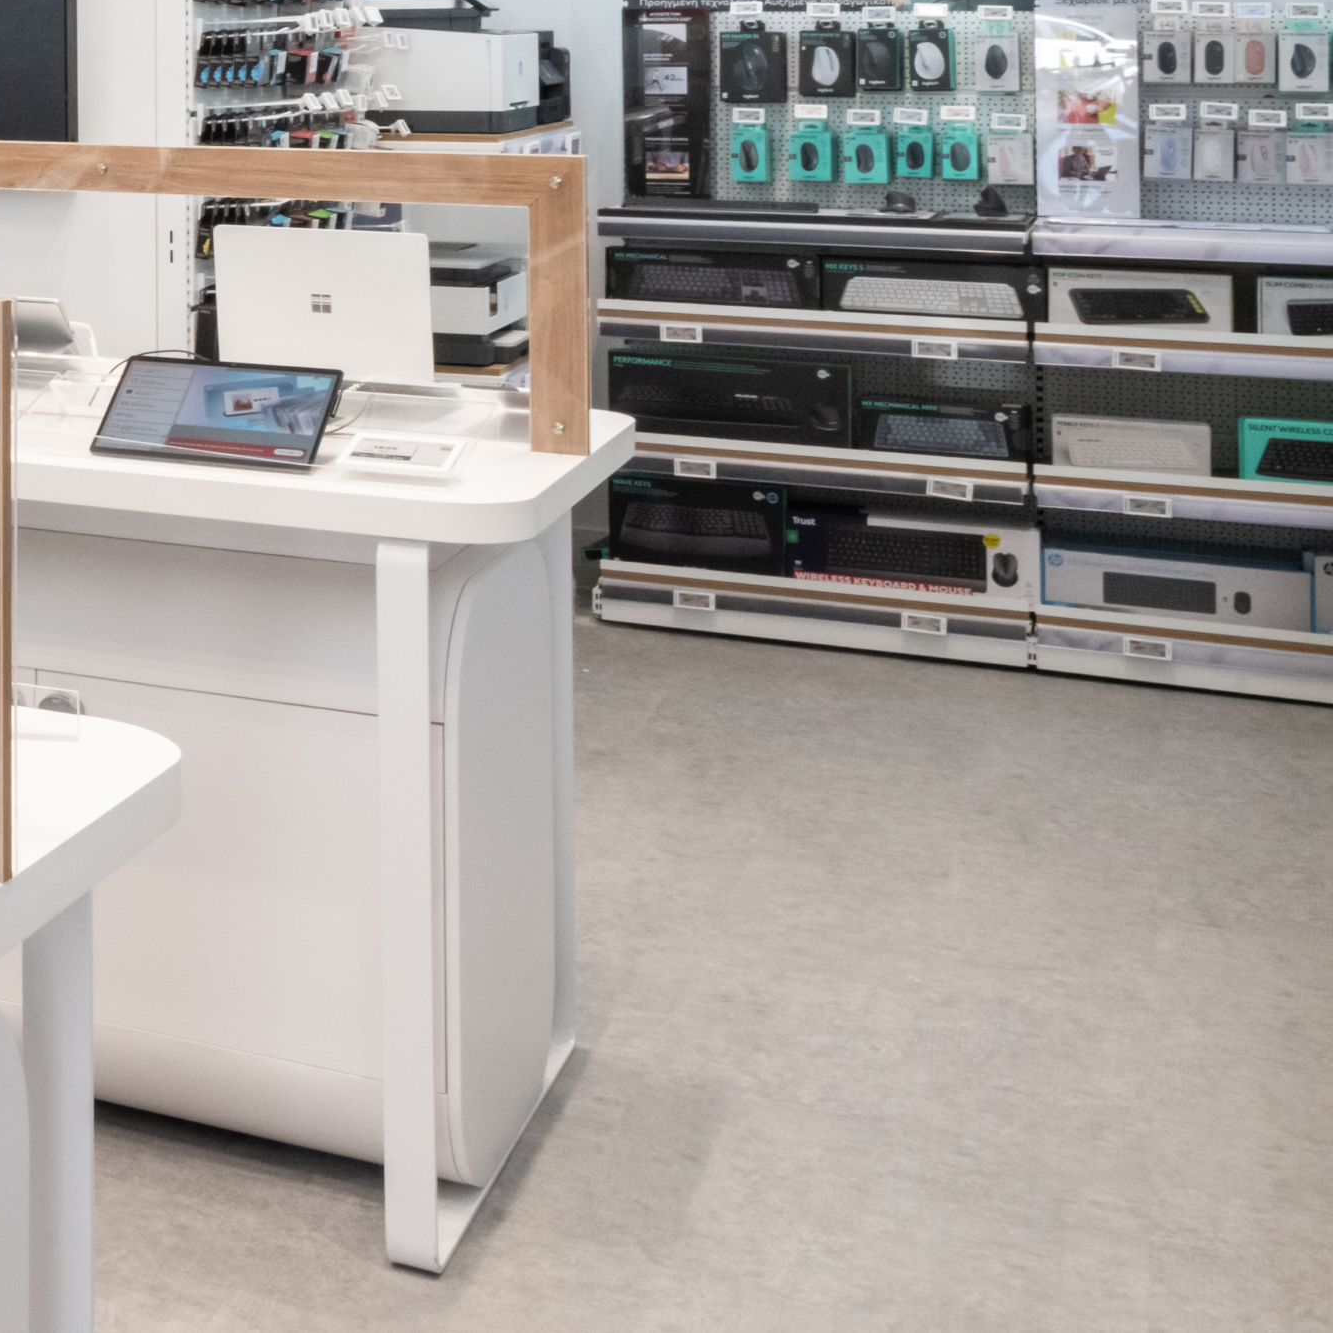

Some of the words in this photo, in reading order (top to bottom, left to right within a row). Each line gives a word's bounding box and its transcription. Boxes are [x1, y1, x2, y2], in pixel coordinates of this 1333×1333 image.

[613, 355, 672, 366] PERFORMANCE
[876, 400, 919, 410] MECHANICAL
[1248, 423, 1276, 433] SILENT
[1278, 424, 1322, 436] WIRELESS
[792, 516, 816, 526] Trust
[794, 570, 851, 584] WIRELESS
[853, 576, 917, 590] KEYBOARD
[928, 583, 973, 597] MOUSE
